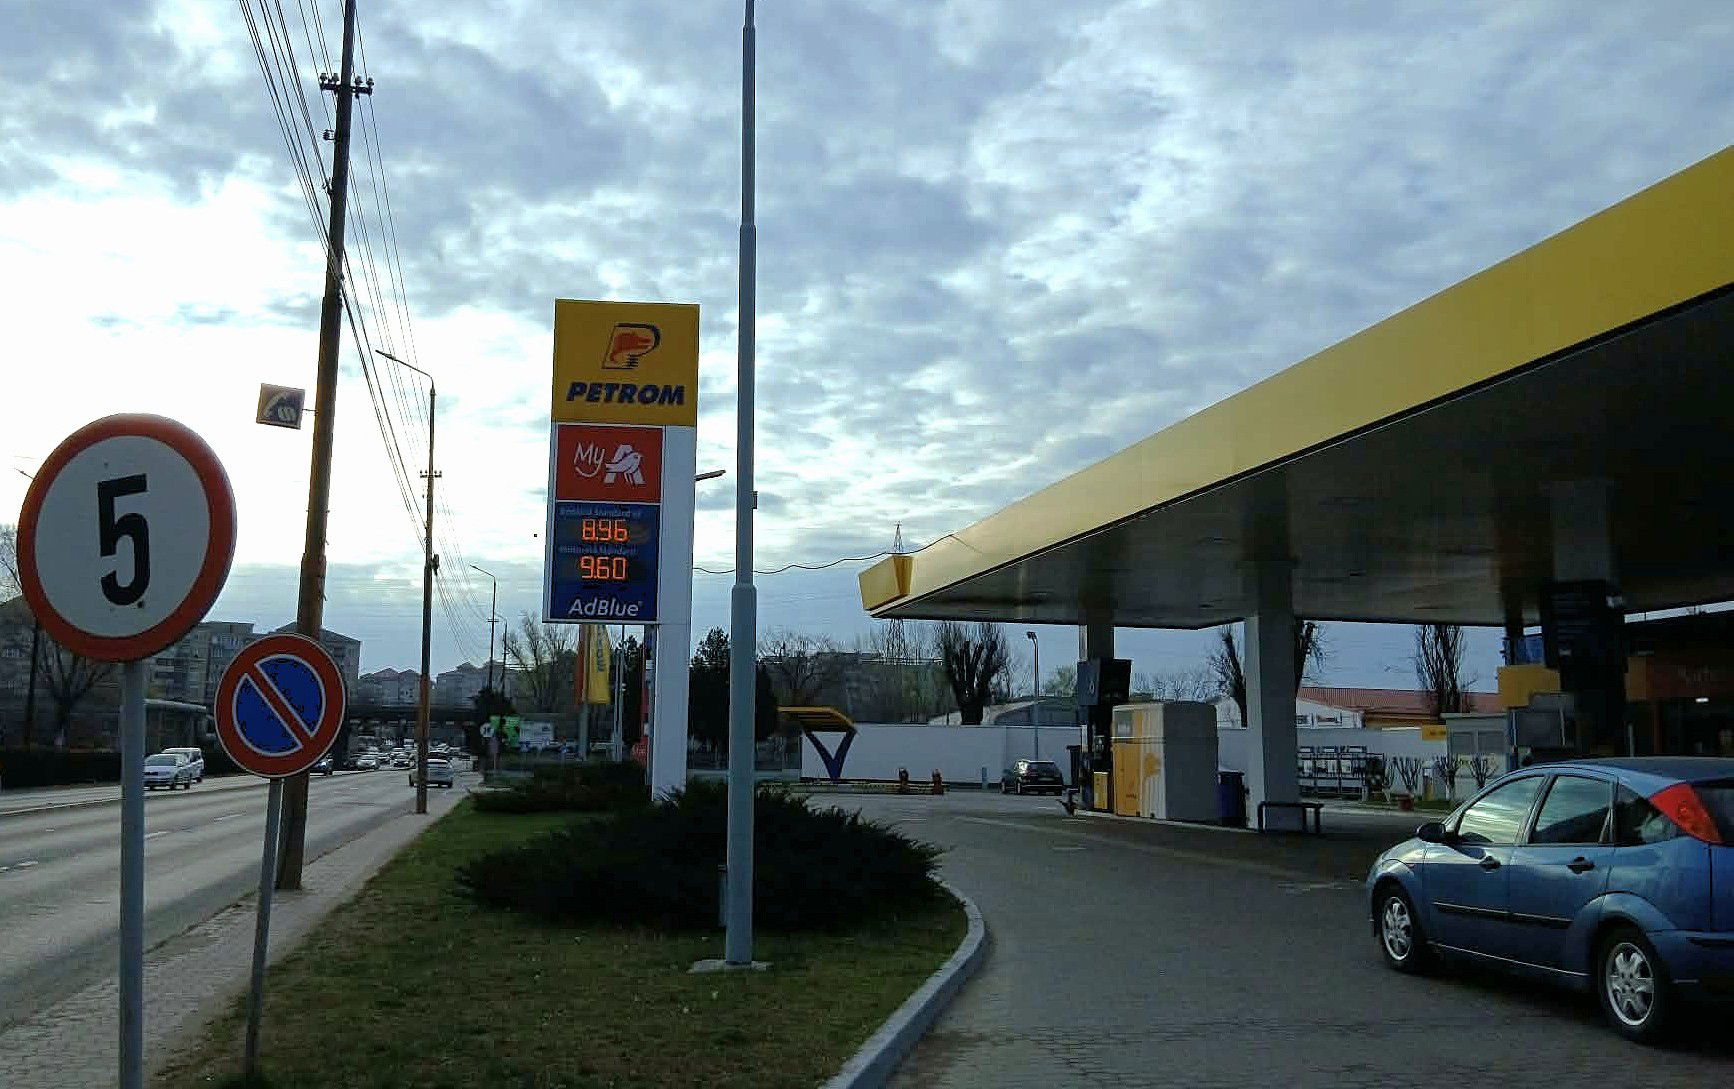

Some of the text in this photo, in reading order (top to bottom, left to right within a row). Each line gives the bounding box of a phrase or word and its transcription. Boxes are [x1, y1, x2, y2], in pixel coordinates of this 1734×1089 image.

[566, 382, 685, 405] PETROM
[574, 441, 605, 477] My
[97, 473, 150, 606] 5
